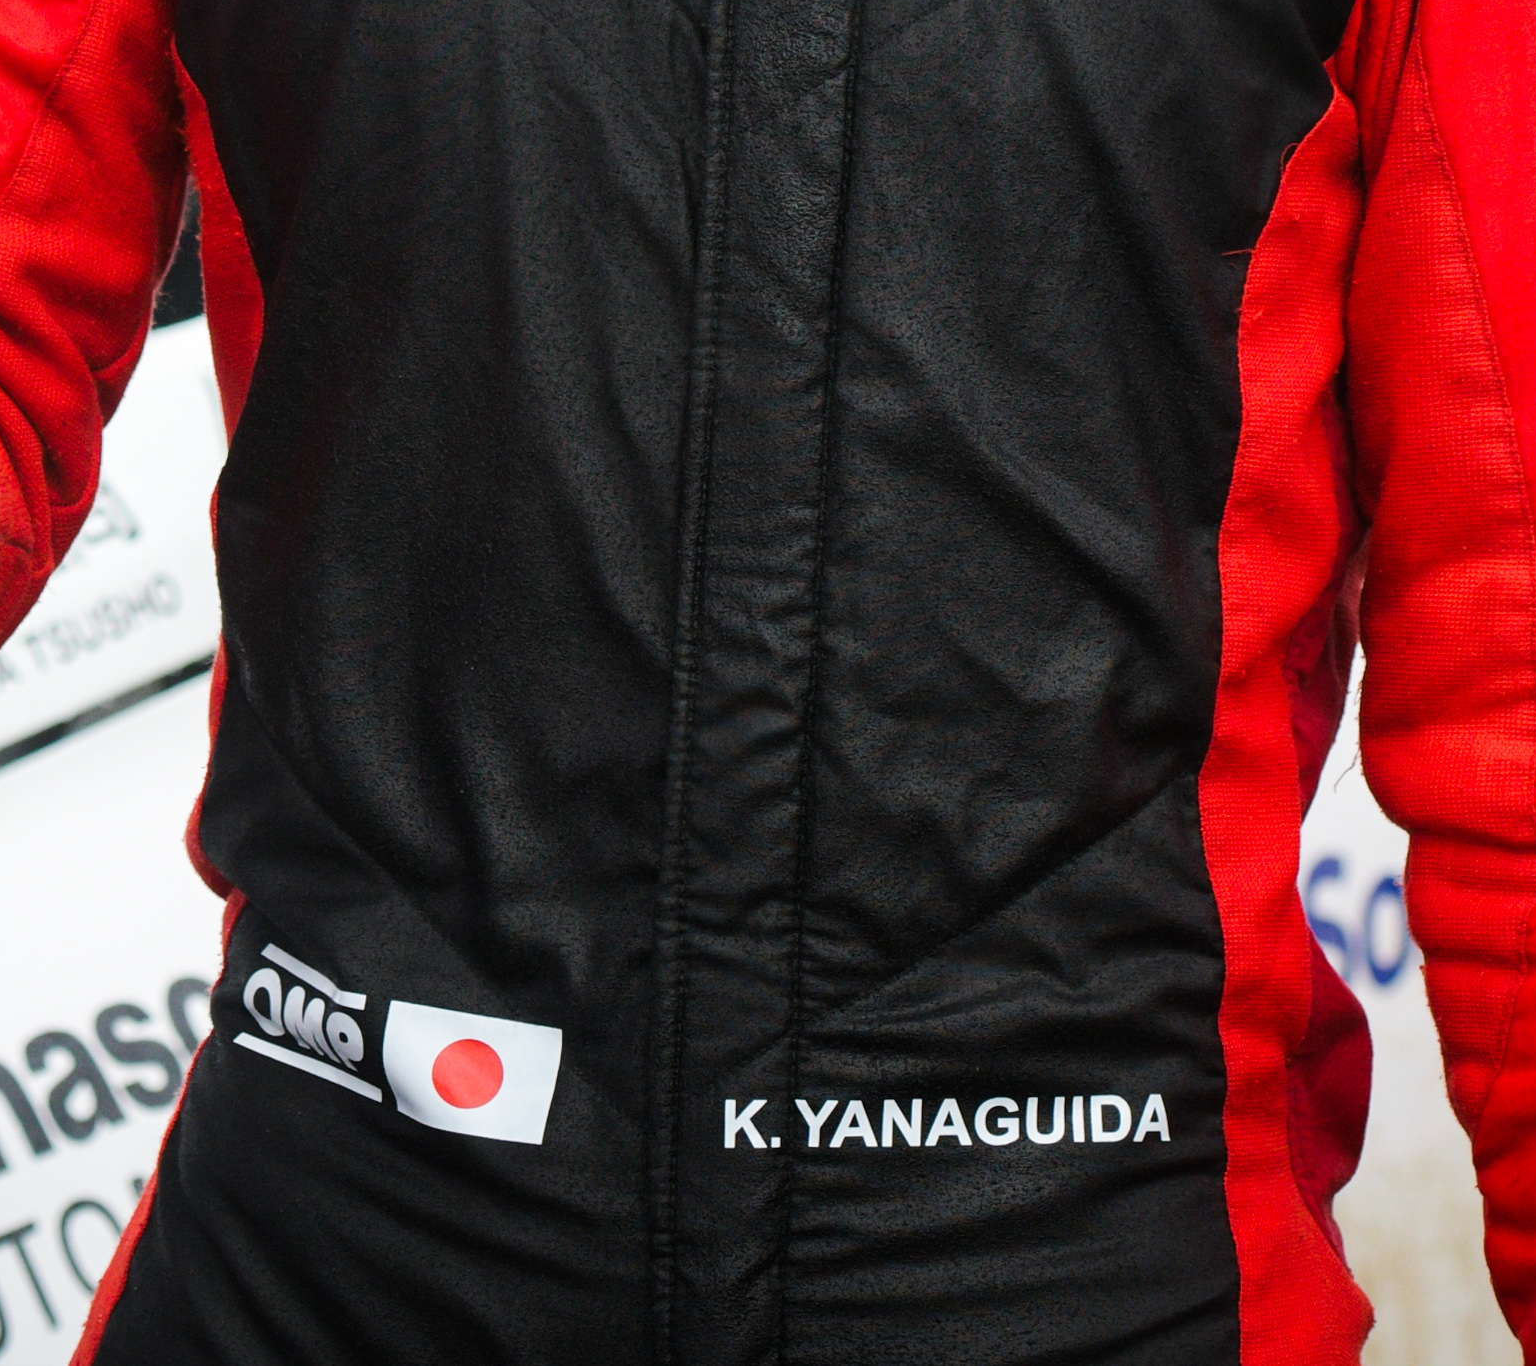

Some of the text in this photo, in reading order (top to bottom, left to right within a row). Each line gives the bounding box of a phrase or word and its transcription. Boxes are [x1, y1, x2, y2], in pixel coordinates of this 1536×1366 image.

[22, 571, 184, 674] TSUSHO
[242, 967, 366, 1074] OMP
[723, 1092, 1172, 1150] K. YANAGUIDA
